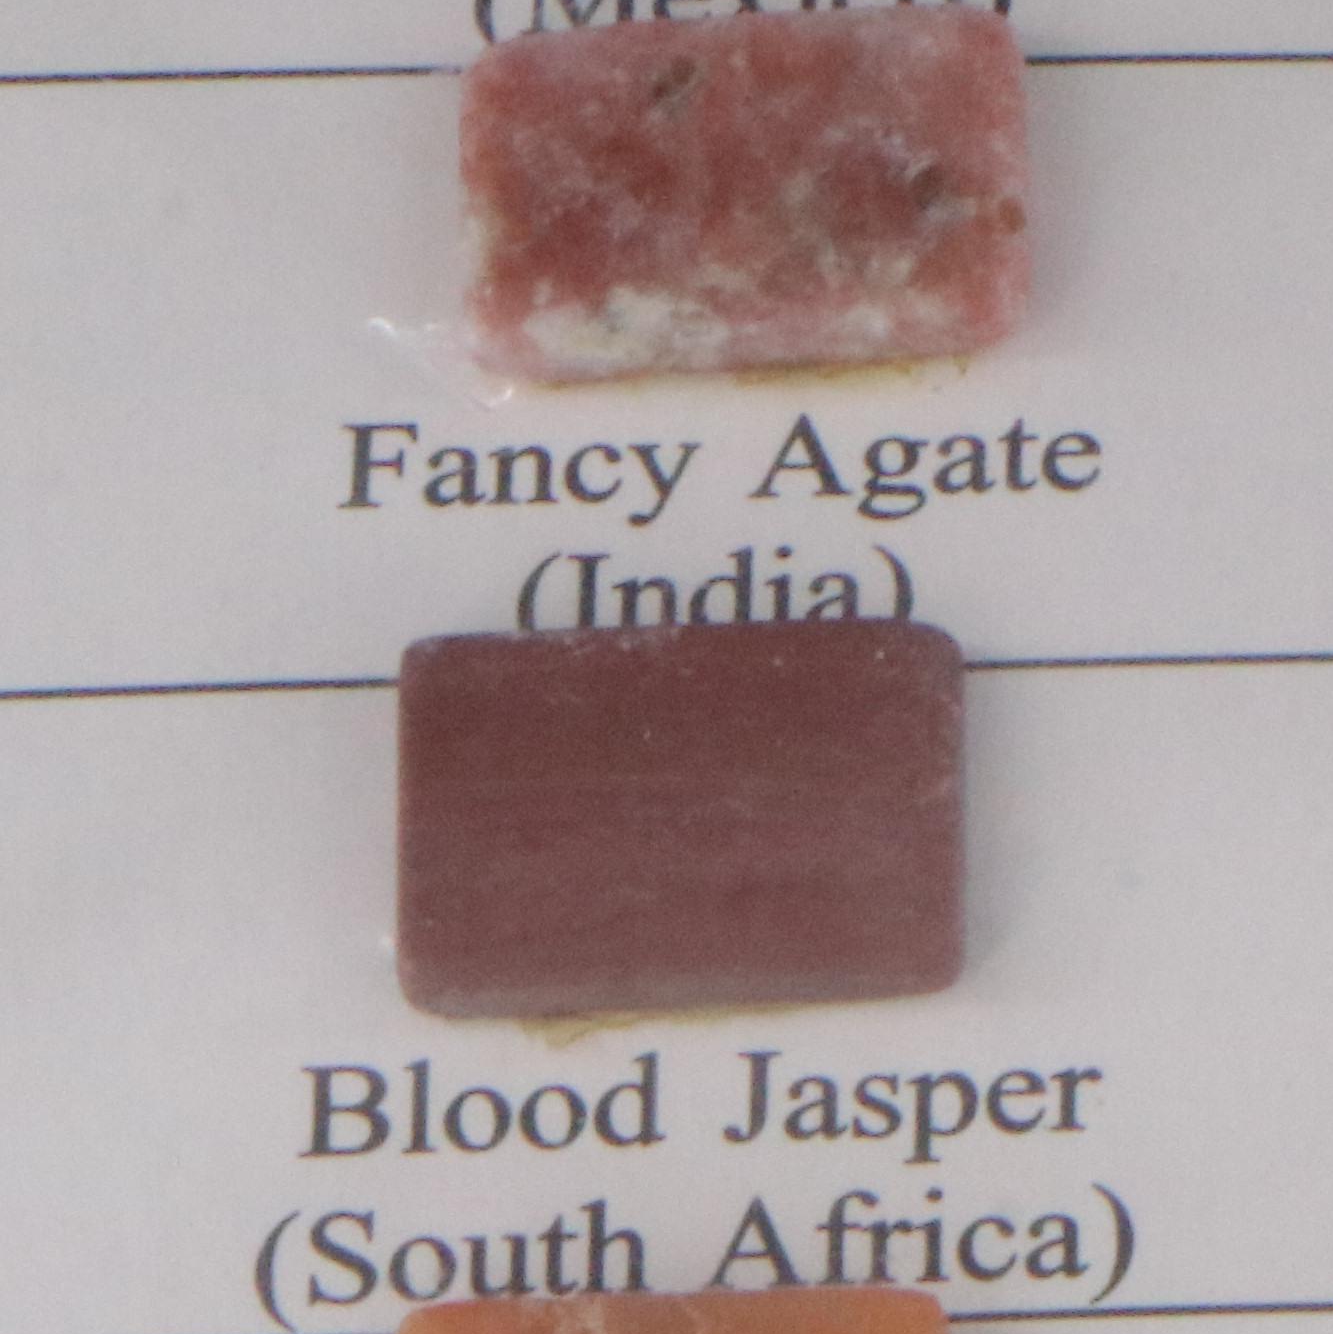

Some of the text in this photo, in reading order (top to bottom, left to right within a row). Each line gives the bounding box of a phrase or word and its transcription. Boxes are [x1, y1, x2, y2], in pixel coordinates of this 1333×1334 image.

[338, 415, 1103, 527] Fancy Agate
[298, 1053, 1104, 1165] Blood Jasper
[253, 1183, 1140, 1334] (South Africa)
